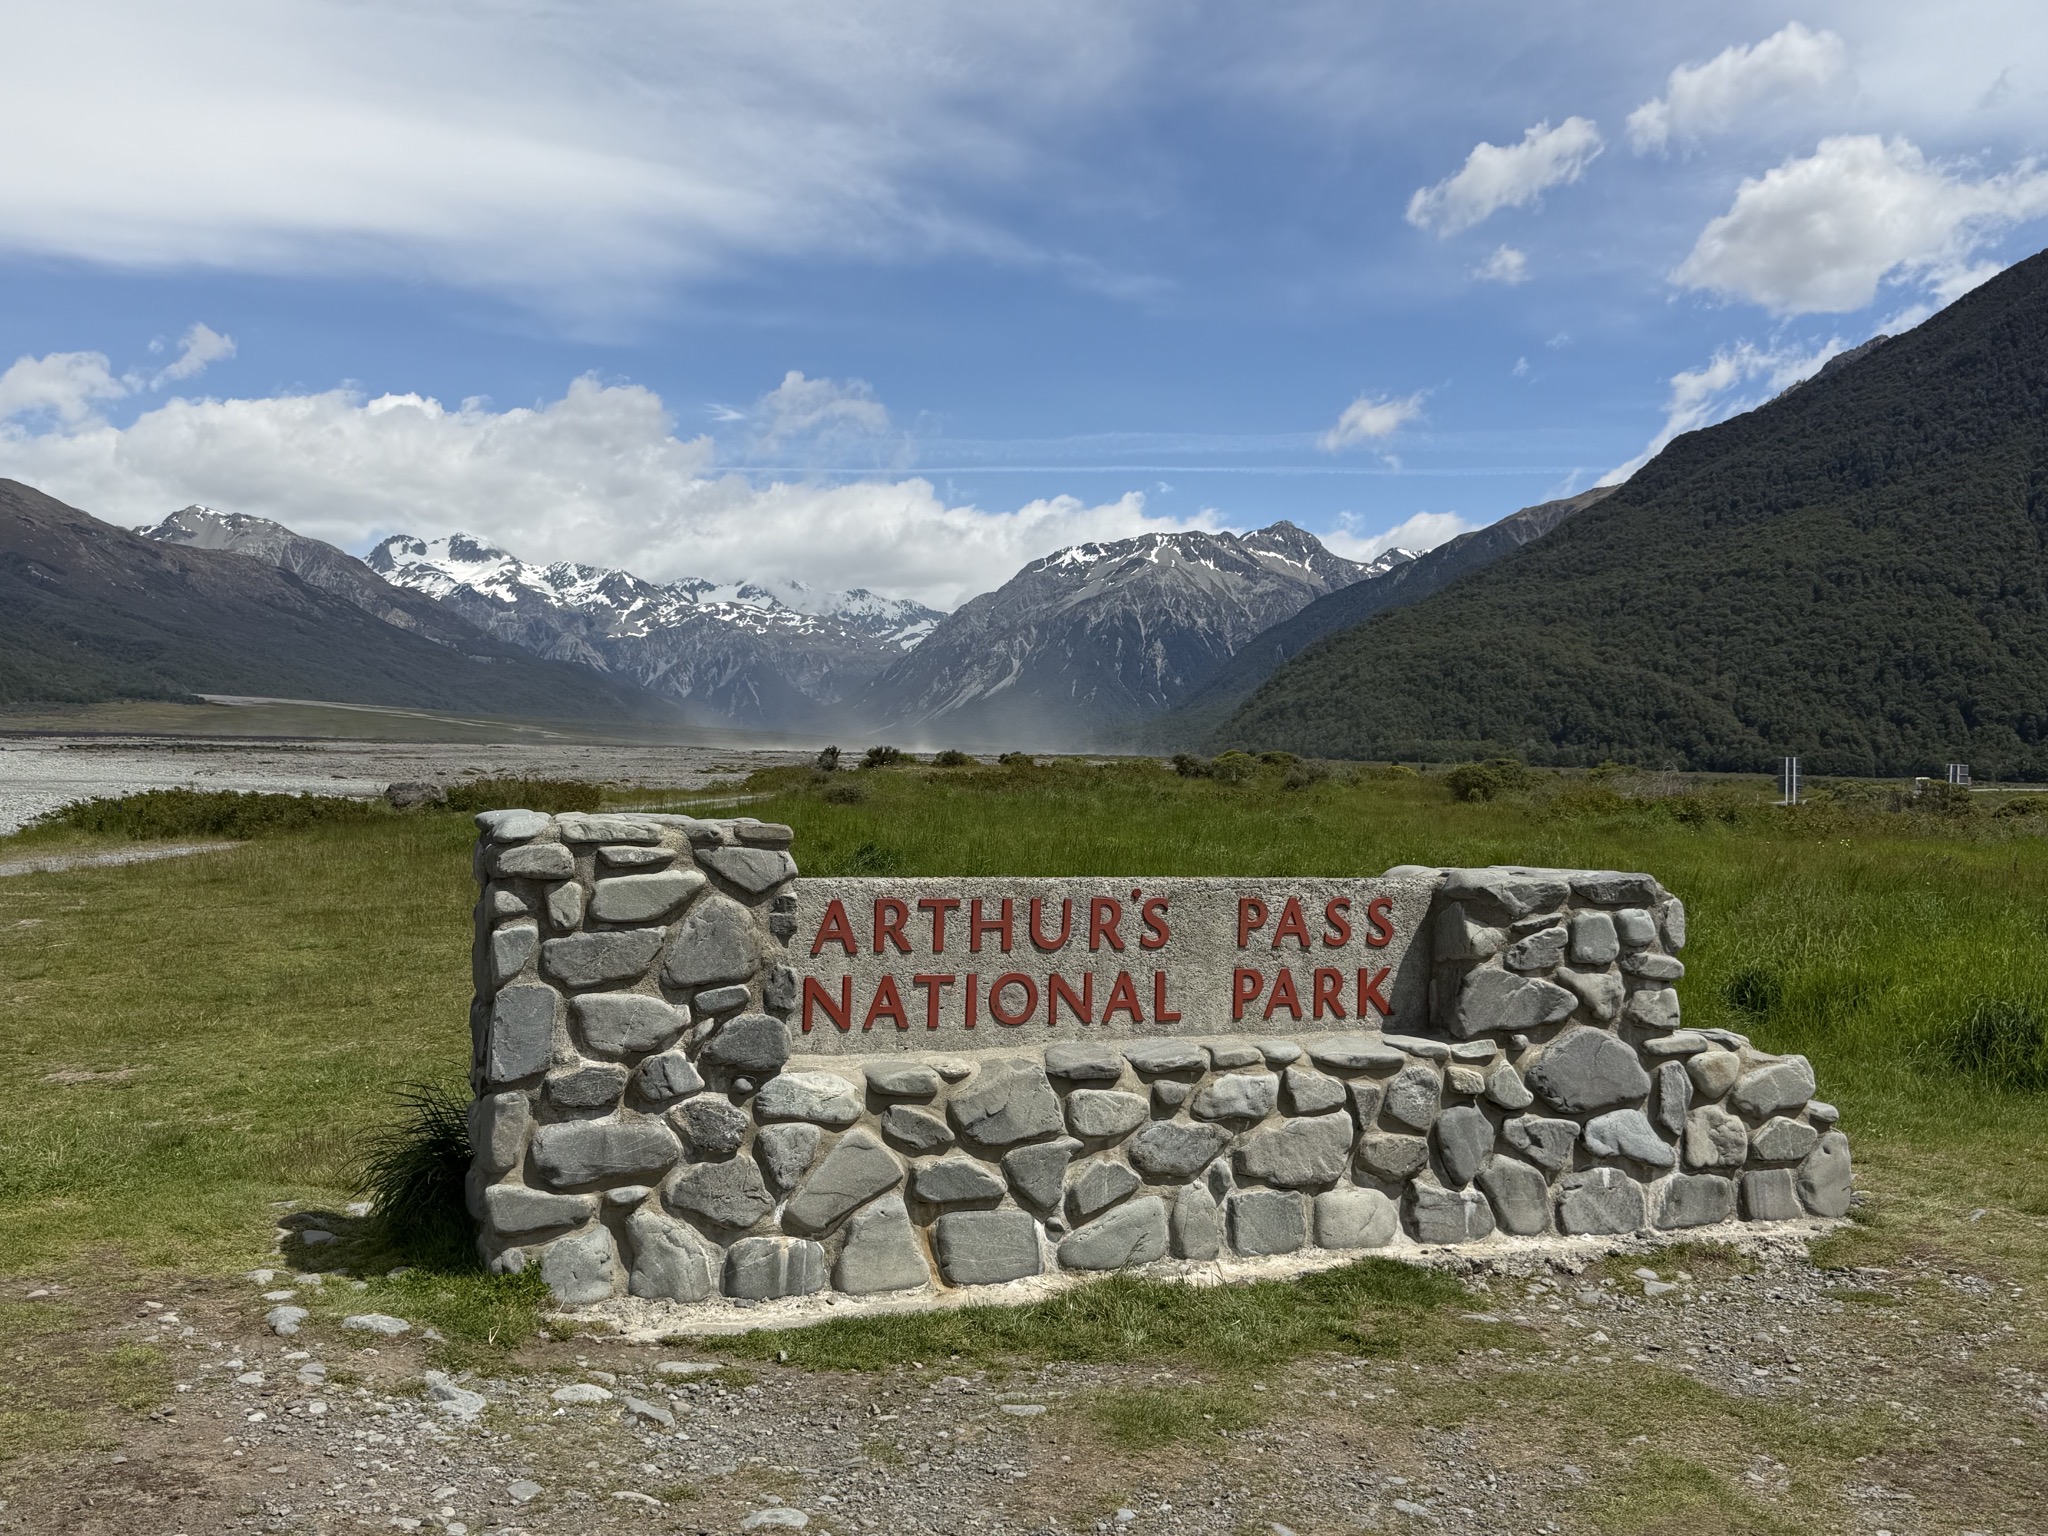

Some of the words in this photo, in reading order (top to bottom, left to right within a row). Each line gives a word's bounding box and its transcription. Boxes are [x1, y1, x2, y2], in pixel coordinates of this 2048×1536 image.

[811, 888, 1170, 954] ARTHUR'S
[1238, 897, 1394, 948] PASS
[803, 971, 1181, 1032] NATIONAL
[1232, 967, 1395, 1020] PARK
